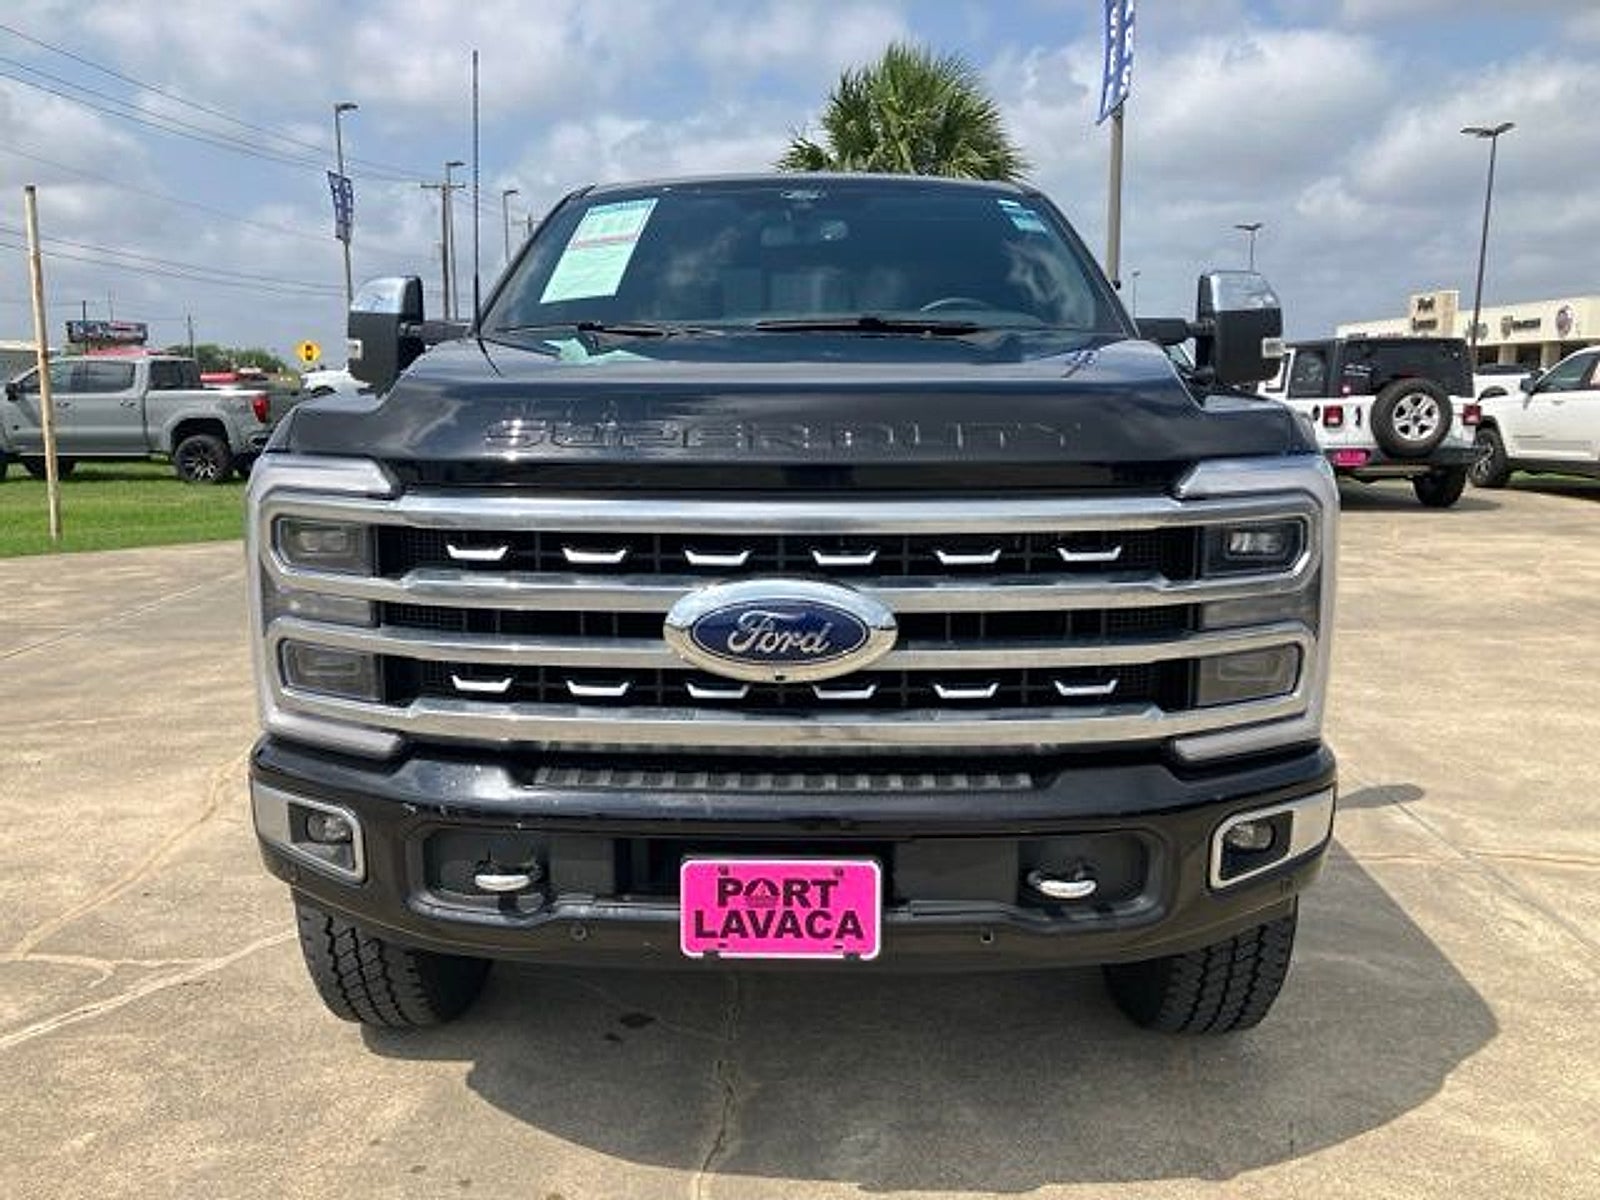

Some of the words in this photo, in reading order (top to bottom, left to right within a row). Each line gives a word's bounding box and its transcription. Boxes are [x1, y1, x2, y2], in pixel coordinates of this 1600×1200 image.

[482, 419, 809, 449] SUPER
[838, 420, 1081, 449] DUTY
[727, 610, 832, 654] Ford
[717, 877, 839, 908] PORT
[694, 909, 864, 939] LAVACA
